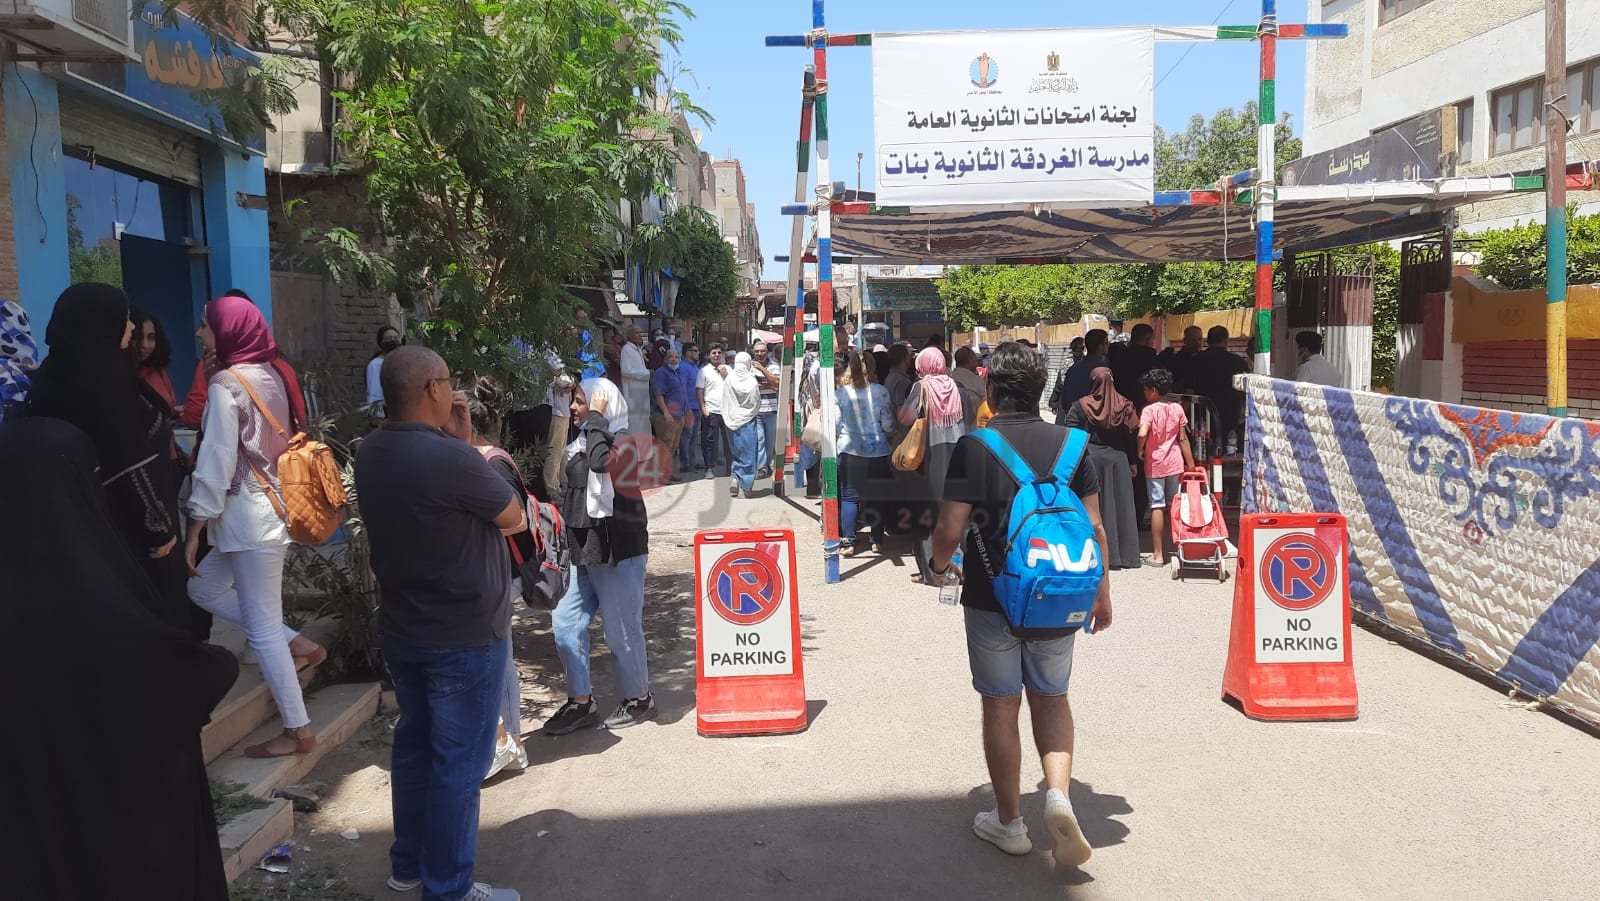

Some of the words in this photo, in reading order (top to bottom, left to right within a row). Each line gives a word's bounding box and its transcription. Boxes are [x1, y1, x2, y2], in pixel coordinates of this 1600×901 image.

[907, 110, 957, 130] العامة
[960, 105, 1020, 132] الثانوية
[1024, 106, 1096, 126] امتحانات
[1100, 105, 1137, 128] لجنة
[884, 152, 930, 180] بنات
[933, 146, 1005, 180] الثانوية
[1009, 146, 1083, 175] الغردقة
[1088, 145, 1150, 173] مدرسة
[1328, 151, 1370, 176] مدرسة
[1027, 538, 1098, 572] FILA
[1286, 618, 1312, 632] NO
[735, 632, 761, 646] NO
[1262, 637, 1338, 651] PARKING
[711, 650, 786, 667] PARKING
